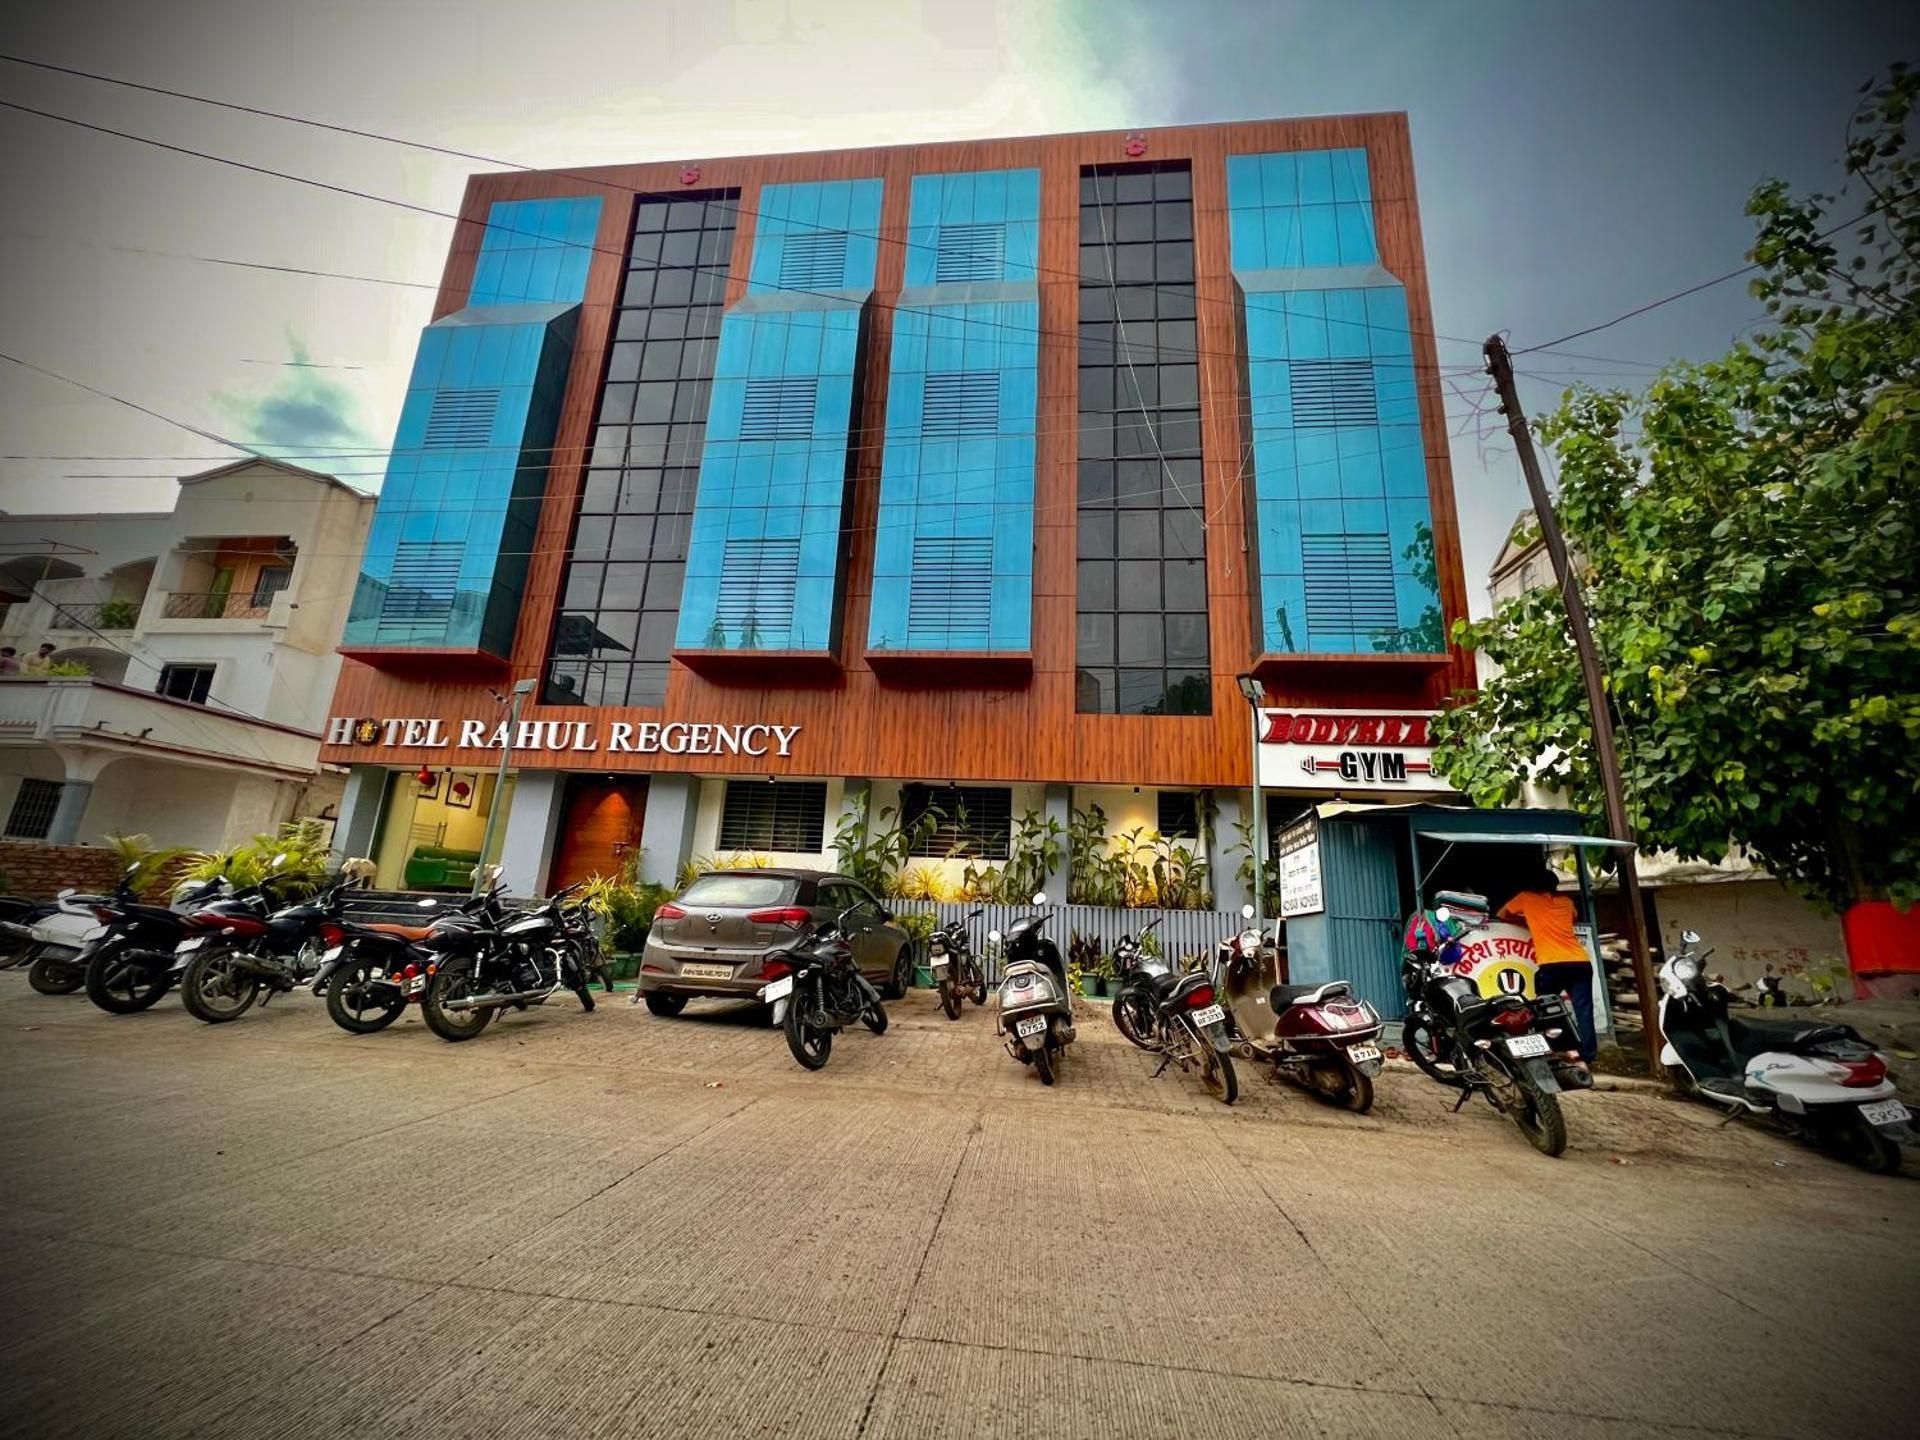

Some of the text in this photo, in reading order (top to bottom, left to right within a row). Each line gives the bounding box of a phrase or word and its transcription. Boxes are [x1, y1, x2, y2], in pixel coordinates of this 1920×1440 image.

[325, 717, 801, 756] HOTEL RAHUL REGENCY
[1339, 751, 1407, 781] GYM
[1020, 1021, 1045, 1036] 0752
